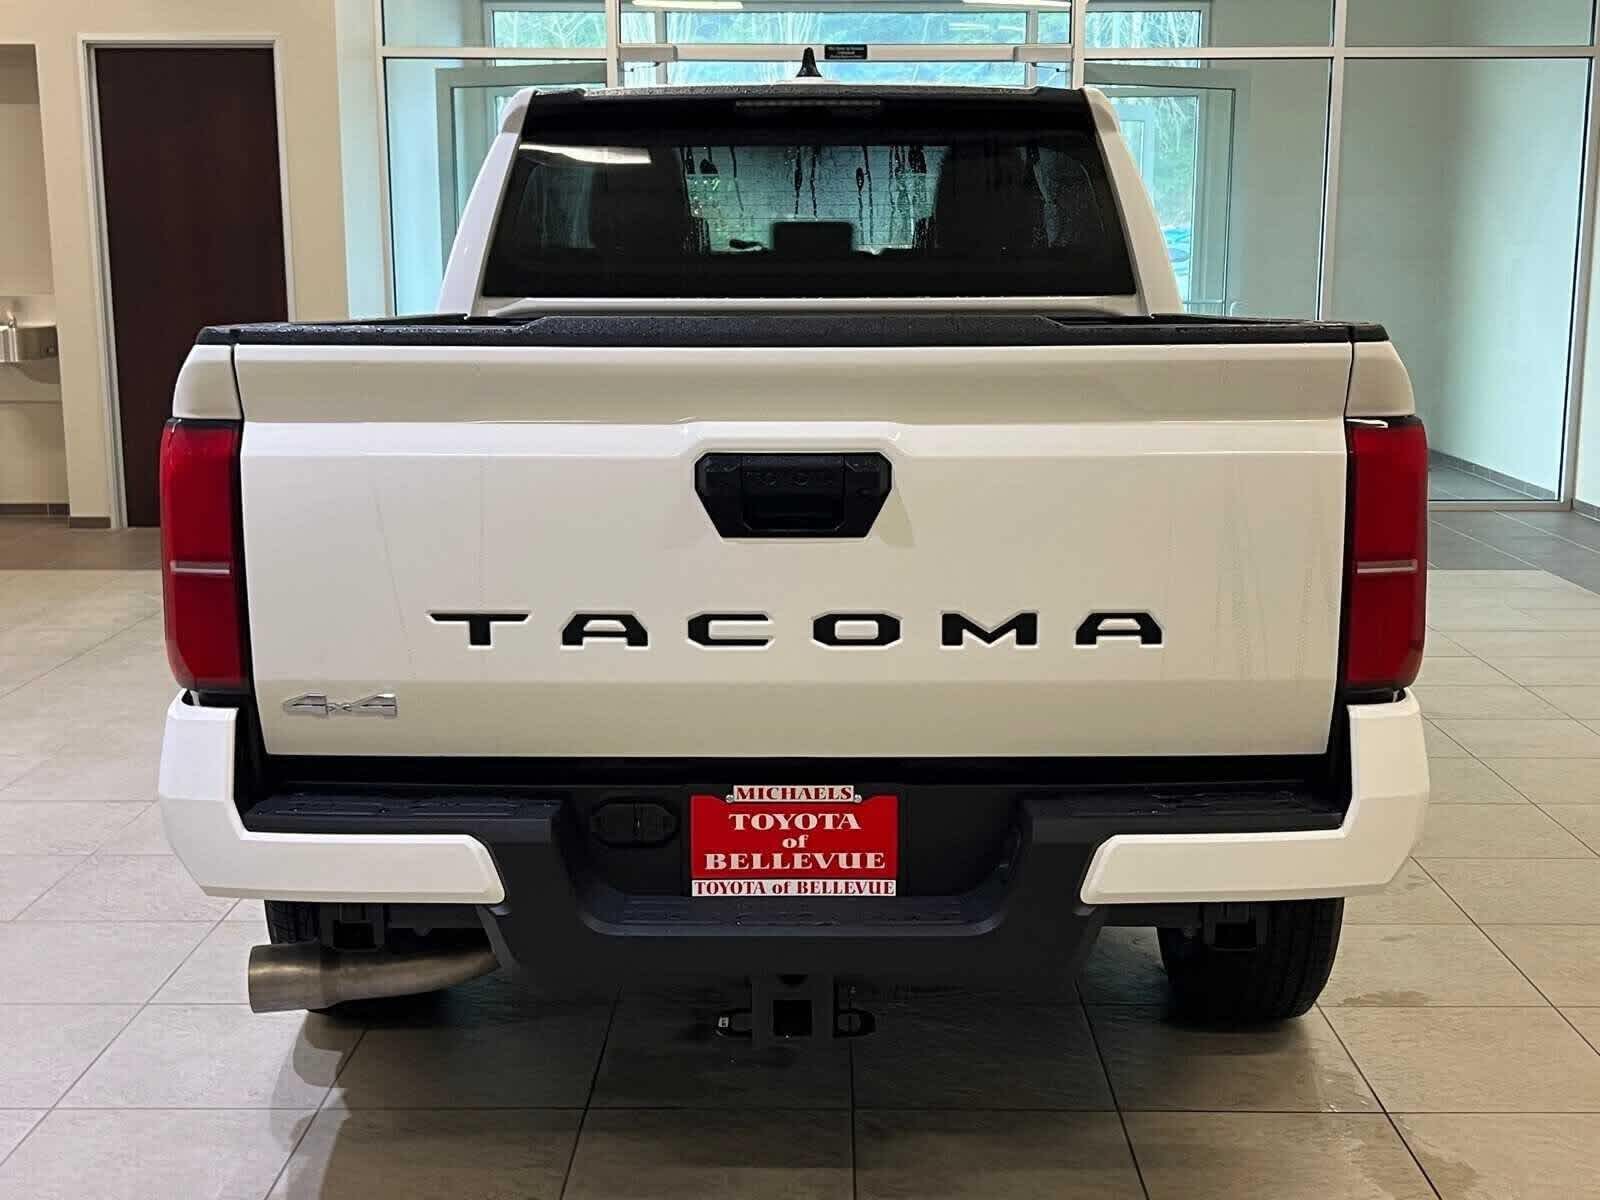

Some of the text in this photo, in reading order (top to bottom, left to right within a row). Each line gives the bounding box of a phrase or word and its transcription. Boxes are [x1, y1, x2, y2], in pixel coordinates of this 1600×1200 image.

[427, 611, 1164, 648] TACOMA
[736, 786, 852, 801] MICHAELS
[729, 813, 861, 830] TOYOTA
[782, 834, 809, 849] of
[704, 852, 886, 870] BELLEVUE
[695, 881, 894, 895] TOYOTA of BELLEVUE
